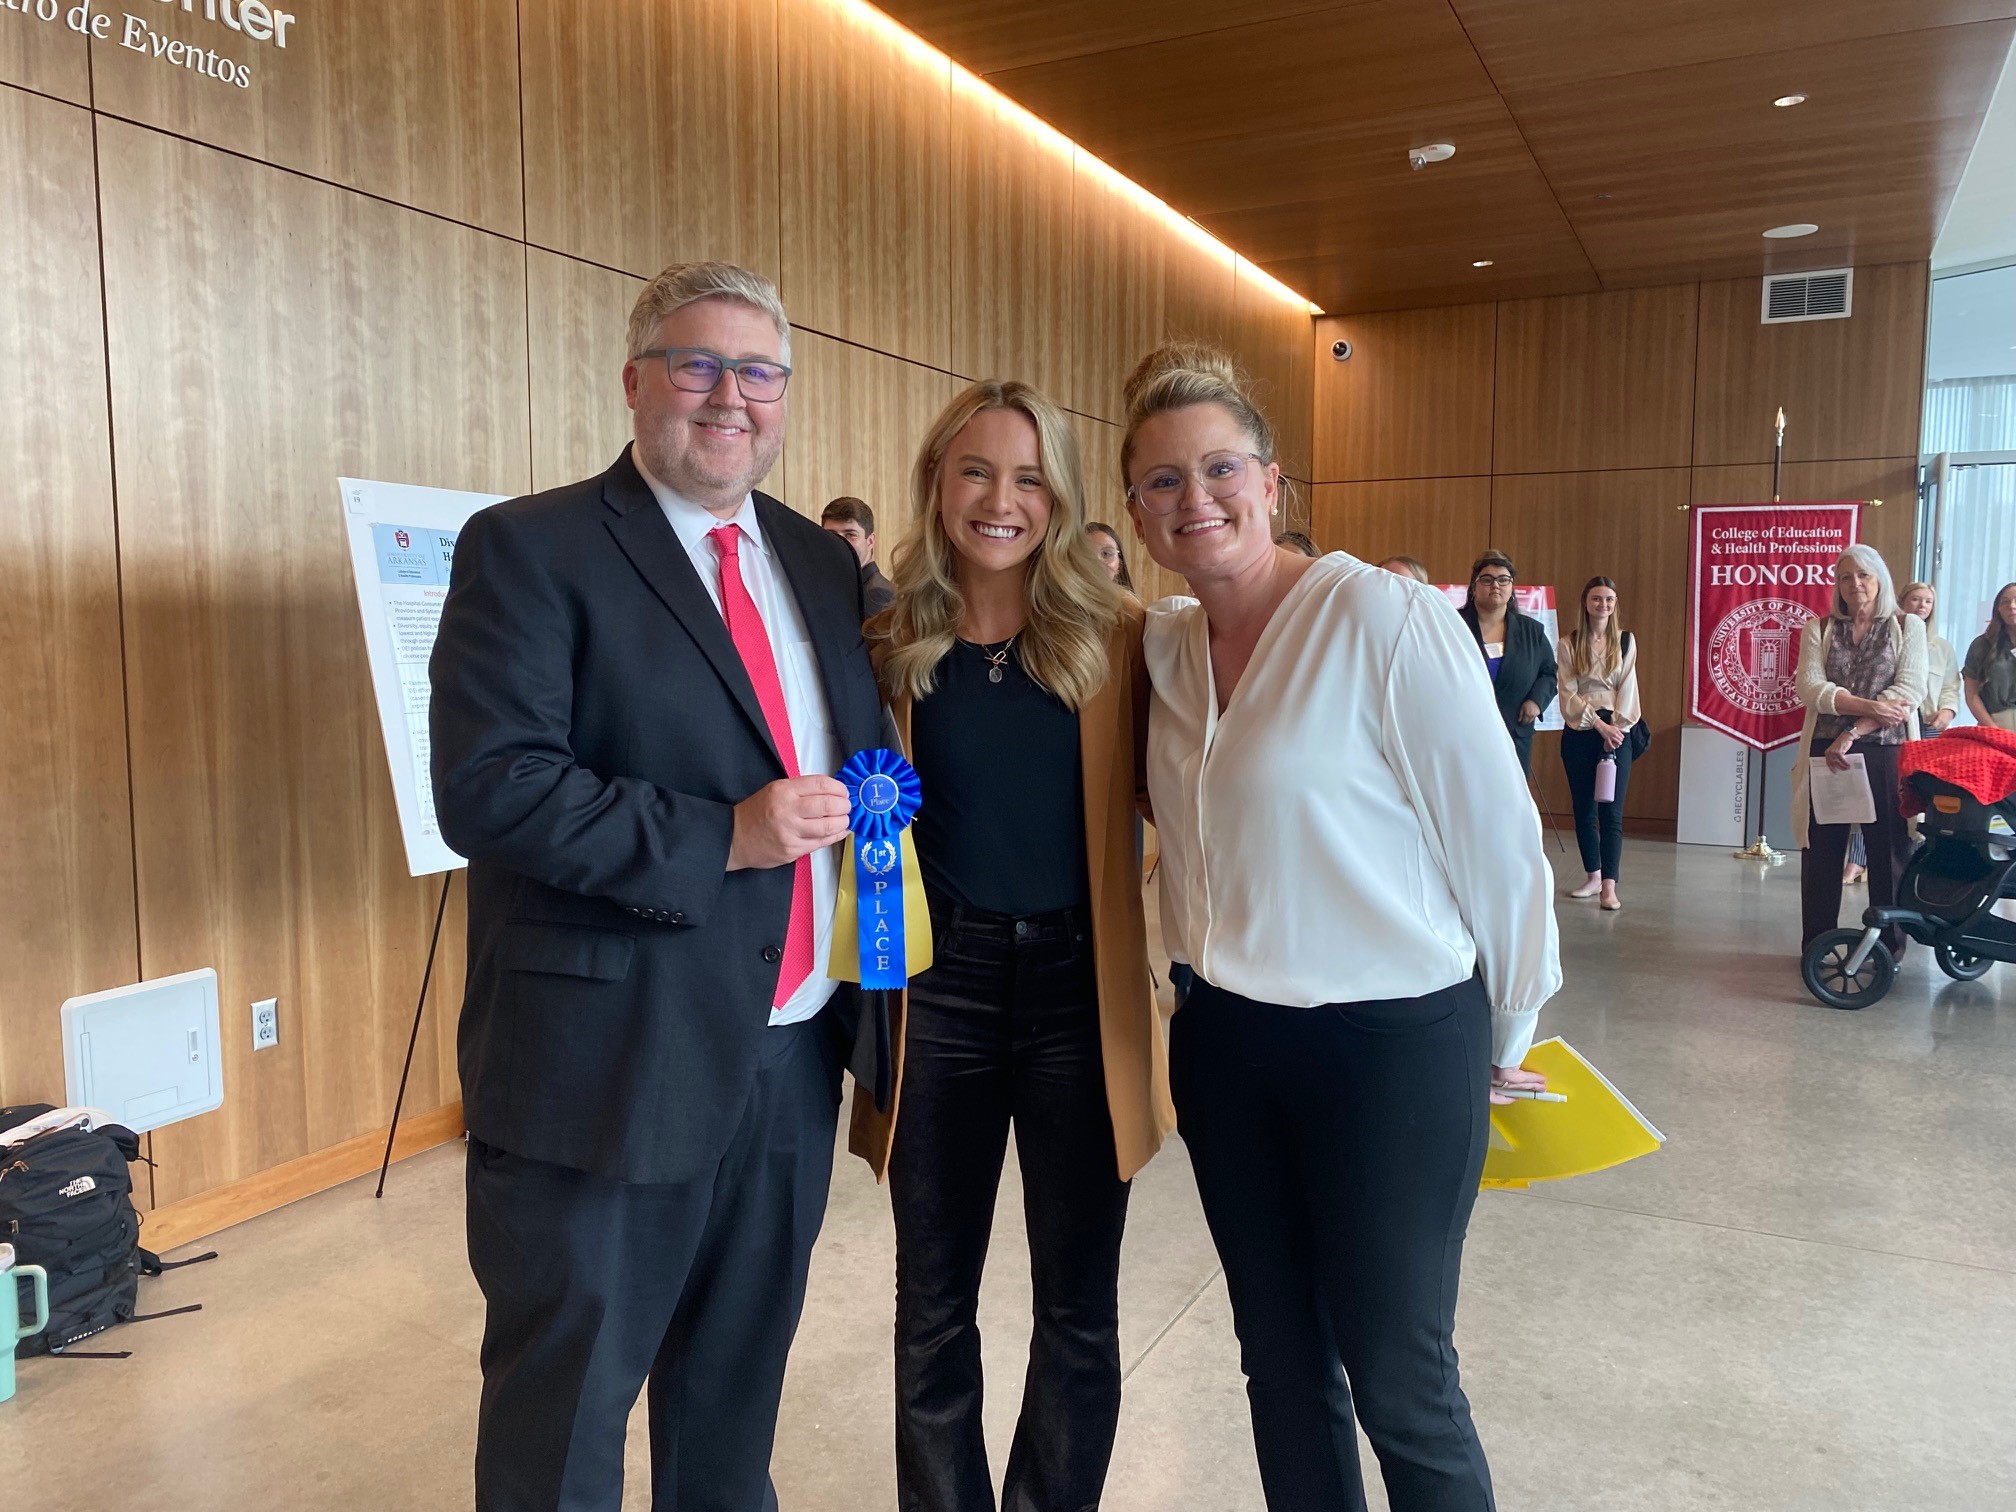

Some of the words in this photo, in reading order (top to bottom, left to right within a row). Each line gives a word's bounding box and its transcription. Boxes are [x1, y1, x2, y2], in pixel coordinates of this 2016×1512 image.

[66, 0, 111, 39] de
[119, 12, 250, 88] Eventos
[1712, 527, 1759, 541] College
[1761, 526, 1776, 538] of
[1778, 526, 1842, 538] Education
[1711, 543, 1722, 555] &
[1725, 542, 1766, 554] Health
[1769, 541, 1843, 554] Professions
[388, 556, 427, 566] ARKANSAS
[1710, 563, 1836, 586] HONORS
[1713, 603, 1764, 648] UNIVERSITY
[1768, 602, 1784, 611] OF
[1713, 664, 1749, 707] VERITATE
[1752, 702, 1782, 711] DUCE
[1734, 750, 1744, 814] RECYCLABLES
[872, 783, 884, 798] 1st
[870, 798, 890, 807] Place
[872, 848, 887, 865] 1st
[874, 881, 891, 971] PLACE
[58, 1183, 83, 1196] NORTH
[70, 1178, 83, 1186] THE
[66, 1188, 85, 1198] FACE
